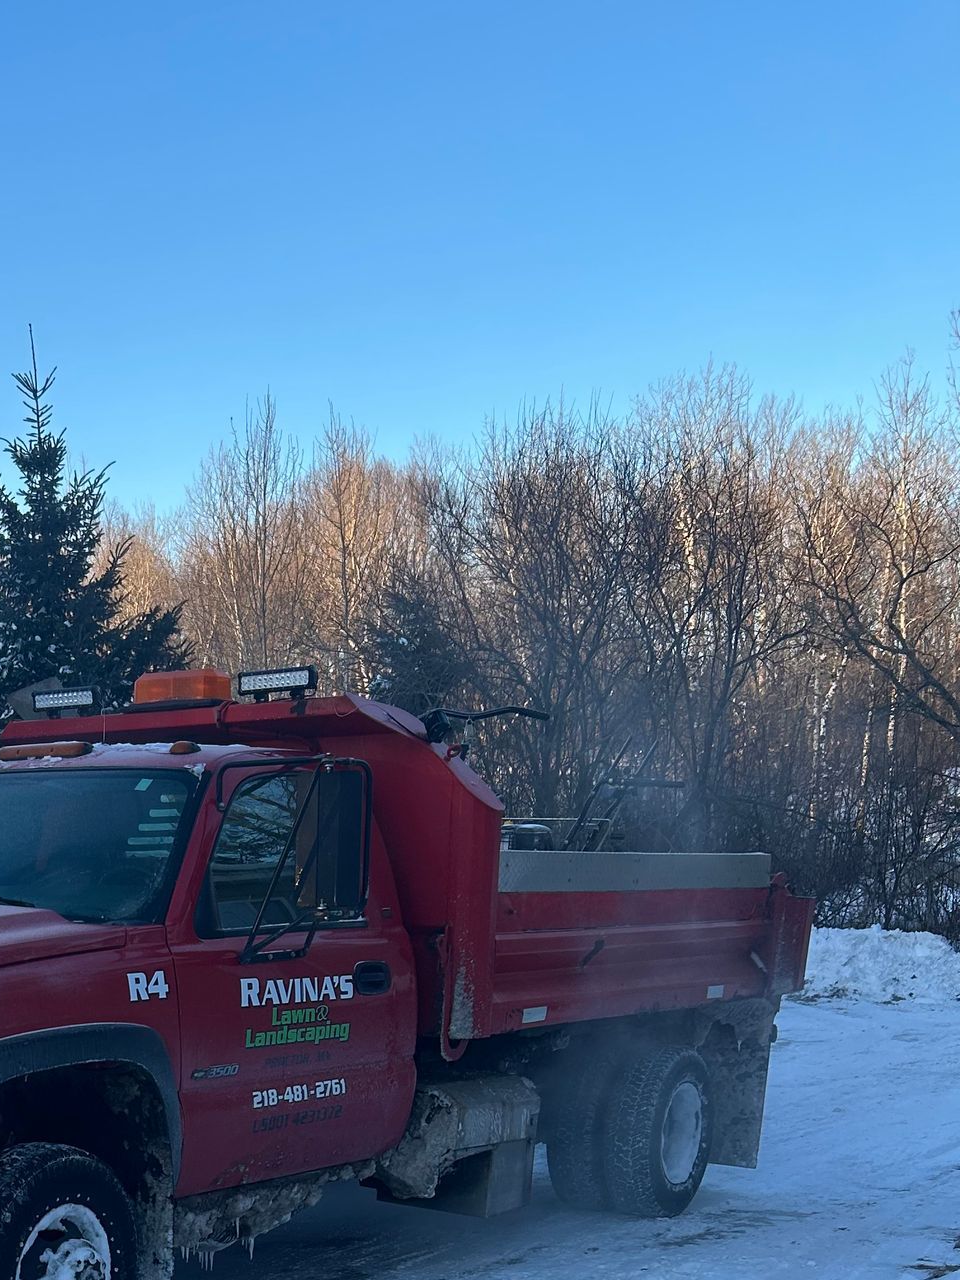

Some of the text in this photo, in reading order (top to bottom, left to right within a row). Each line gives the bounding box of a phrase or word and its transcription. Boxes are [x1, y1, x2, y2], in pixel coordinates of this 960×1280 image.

[127, 970, 169, 1001] R4
[240, 974, 355, 1007] RAVINA'S
[245, 1020, 351, 1048] Landscaping
[207, 1063, 240, 1079] 3500
[252, 1078, 346, 1109] 218-481-2761
